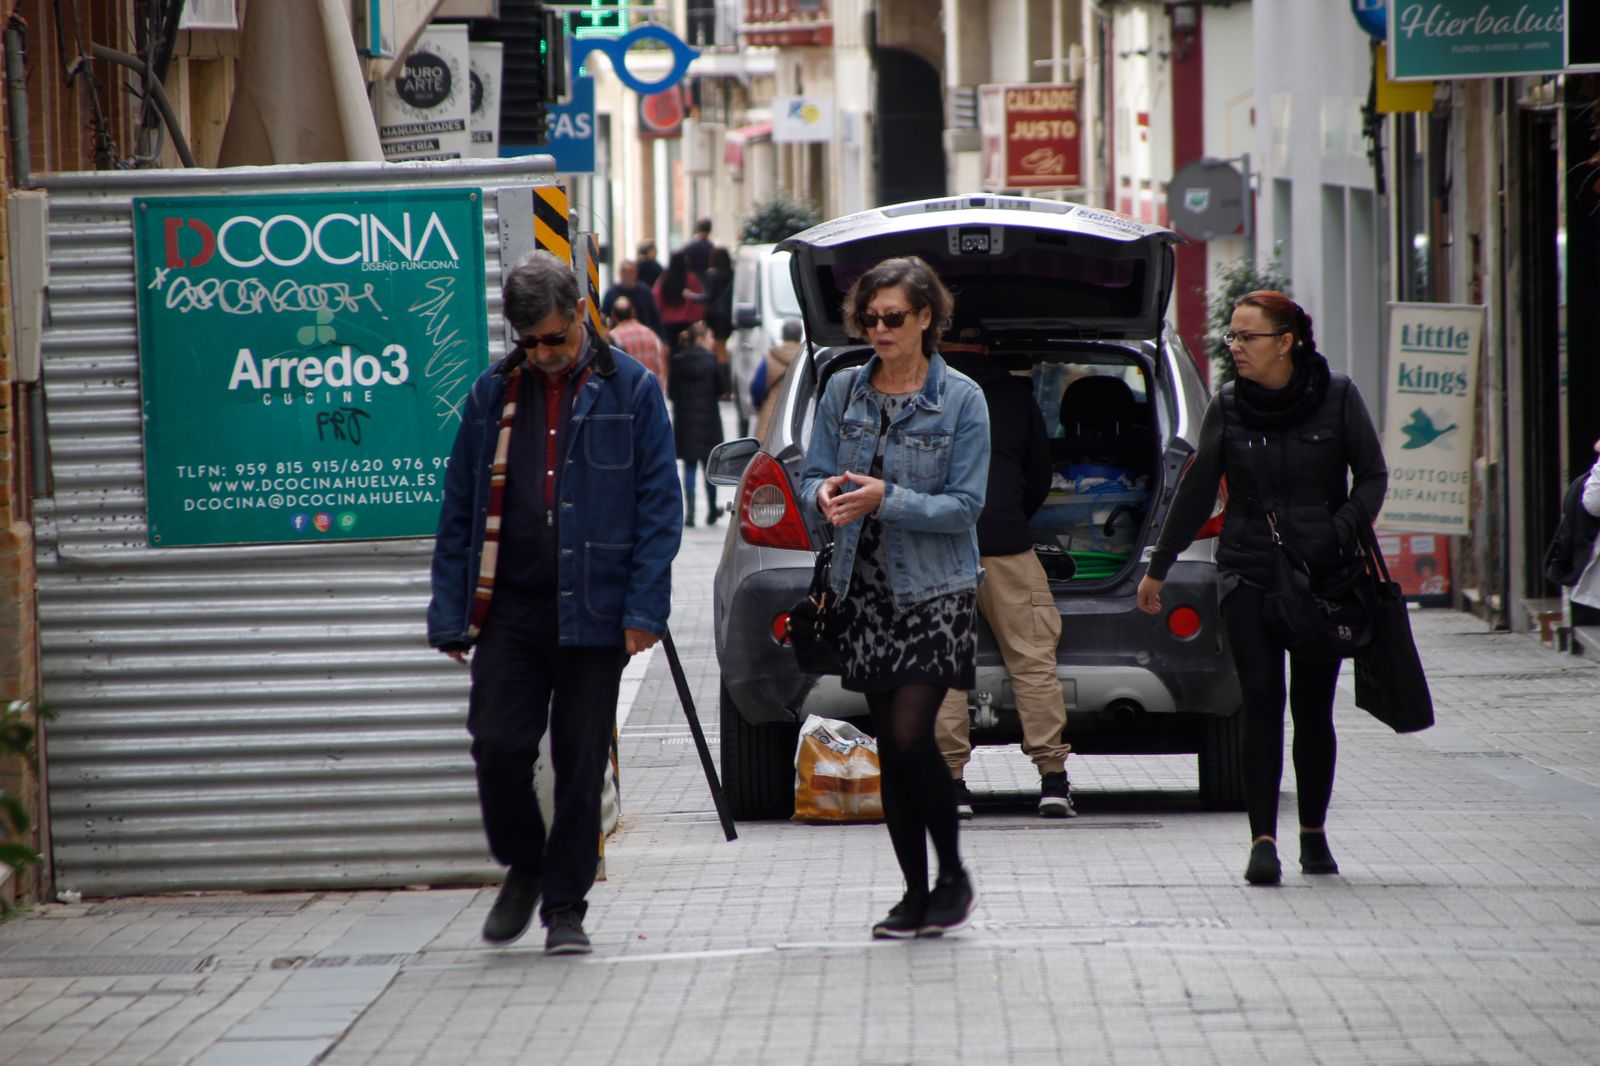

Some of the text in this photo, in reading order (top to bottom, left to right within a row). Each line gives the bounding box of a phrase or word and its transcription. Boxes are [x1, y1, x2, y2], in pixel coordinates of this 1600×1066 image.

[1400, 3, 1564, 38] Hierbaluis
[405, 65, 443, 79] PURO
[404, 78, 443, 92] ARTE
[1006, 90, 1075, 112] CALZADOS
[382, 120, 461, 137] MANUALIDADES
[1010, 120, 1075, 140] JUSTO
[383, 140, 435, 154] MERCERÍA
[163, 211, 460, 268] DCOCINA
[361, 260, 460, 271] DISEÑO FUNCIONAL
[1400, 323, 1470, 350] Little
[227, 343, 409, 390] Arredo3
[1397, 362, 1468, 395] kings
[262, 390, 373, 406] CUCINE
[176, 465, 227, 479] TLFN:
[235, 462, 268, 476] 959
[275, 461, 303, 475] 815
[312, 458, 384, 474] 915/620
[391, 457, 424, 472] 976
[1387, 468, 1469, 485] OUTIQUE
[208, 473, 436, 493] WWW.DCOCINAHUELVA.ES
[184, 489, 446, 512] DCOCINA@DCOCINAHUELVA.
